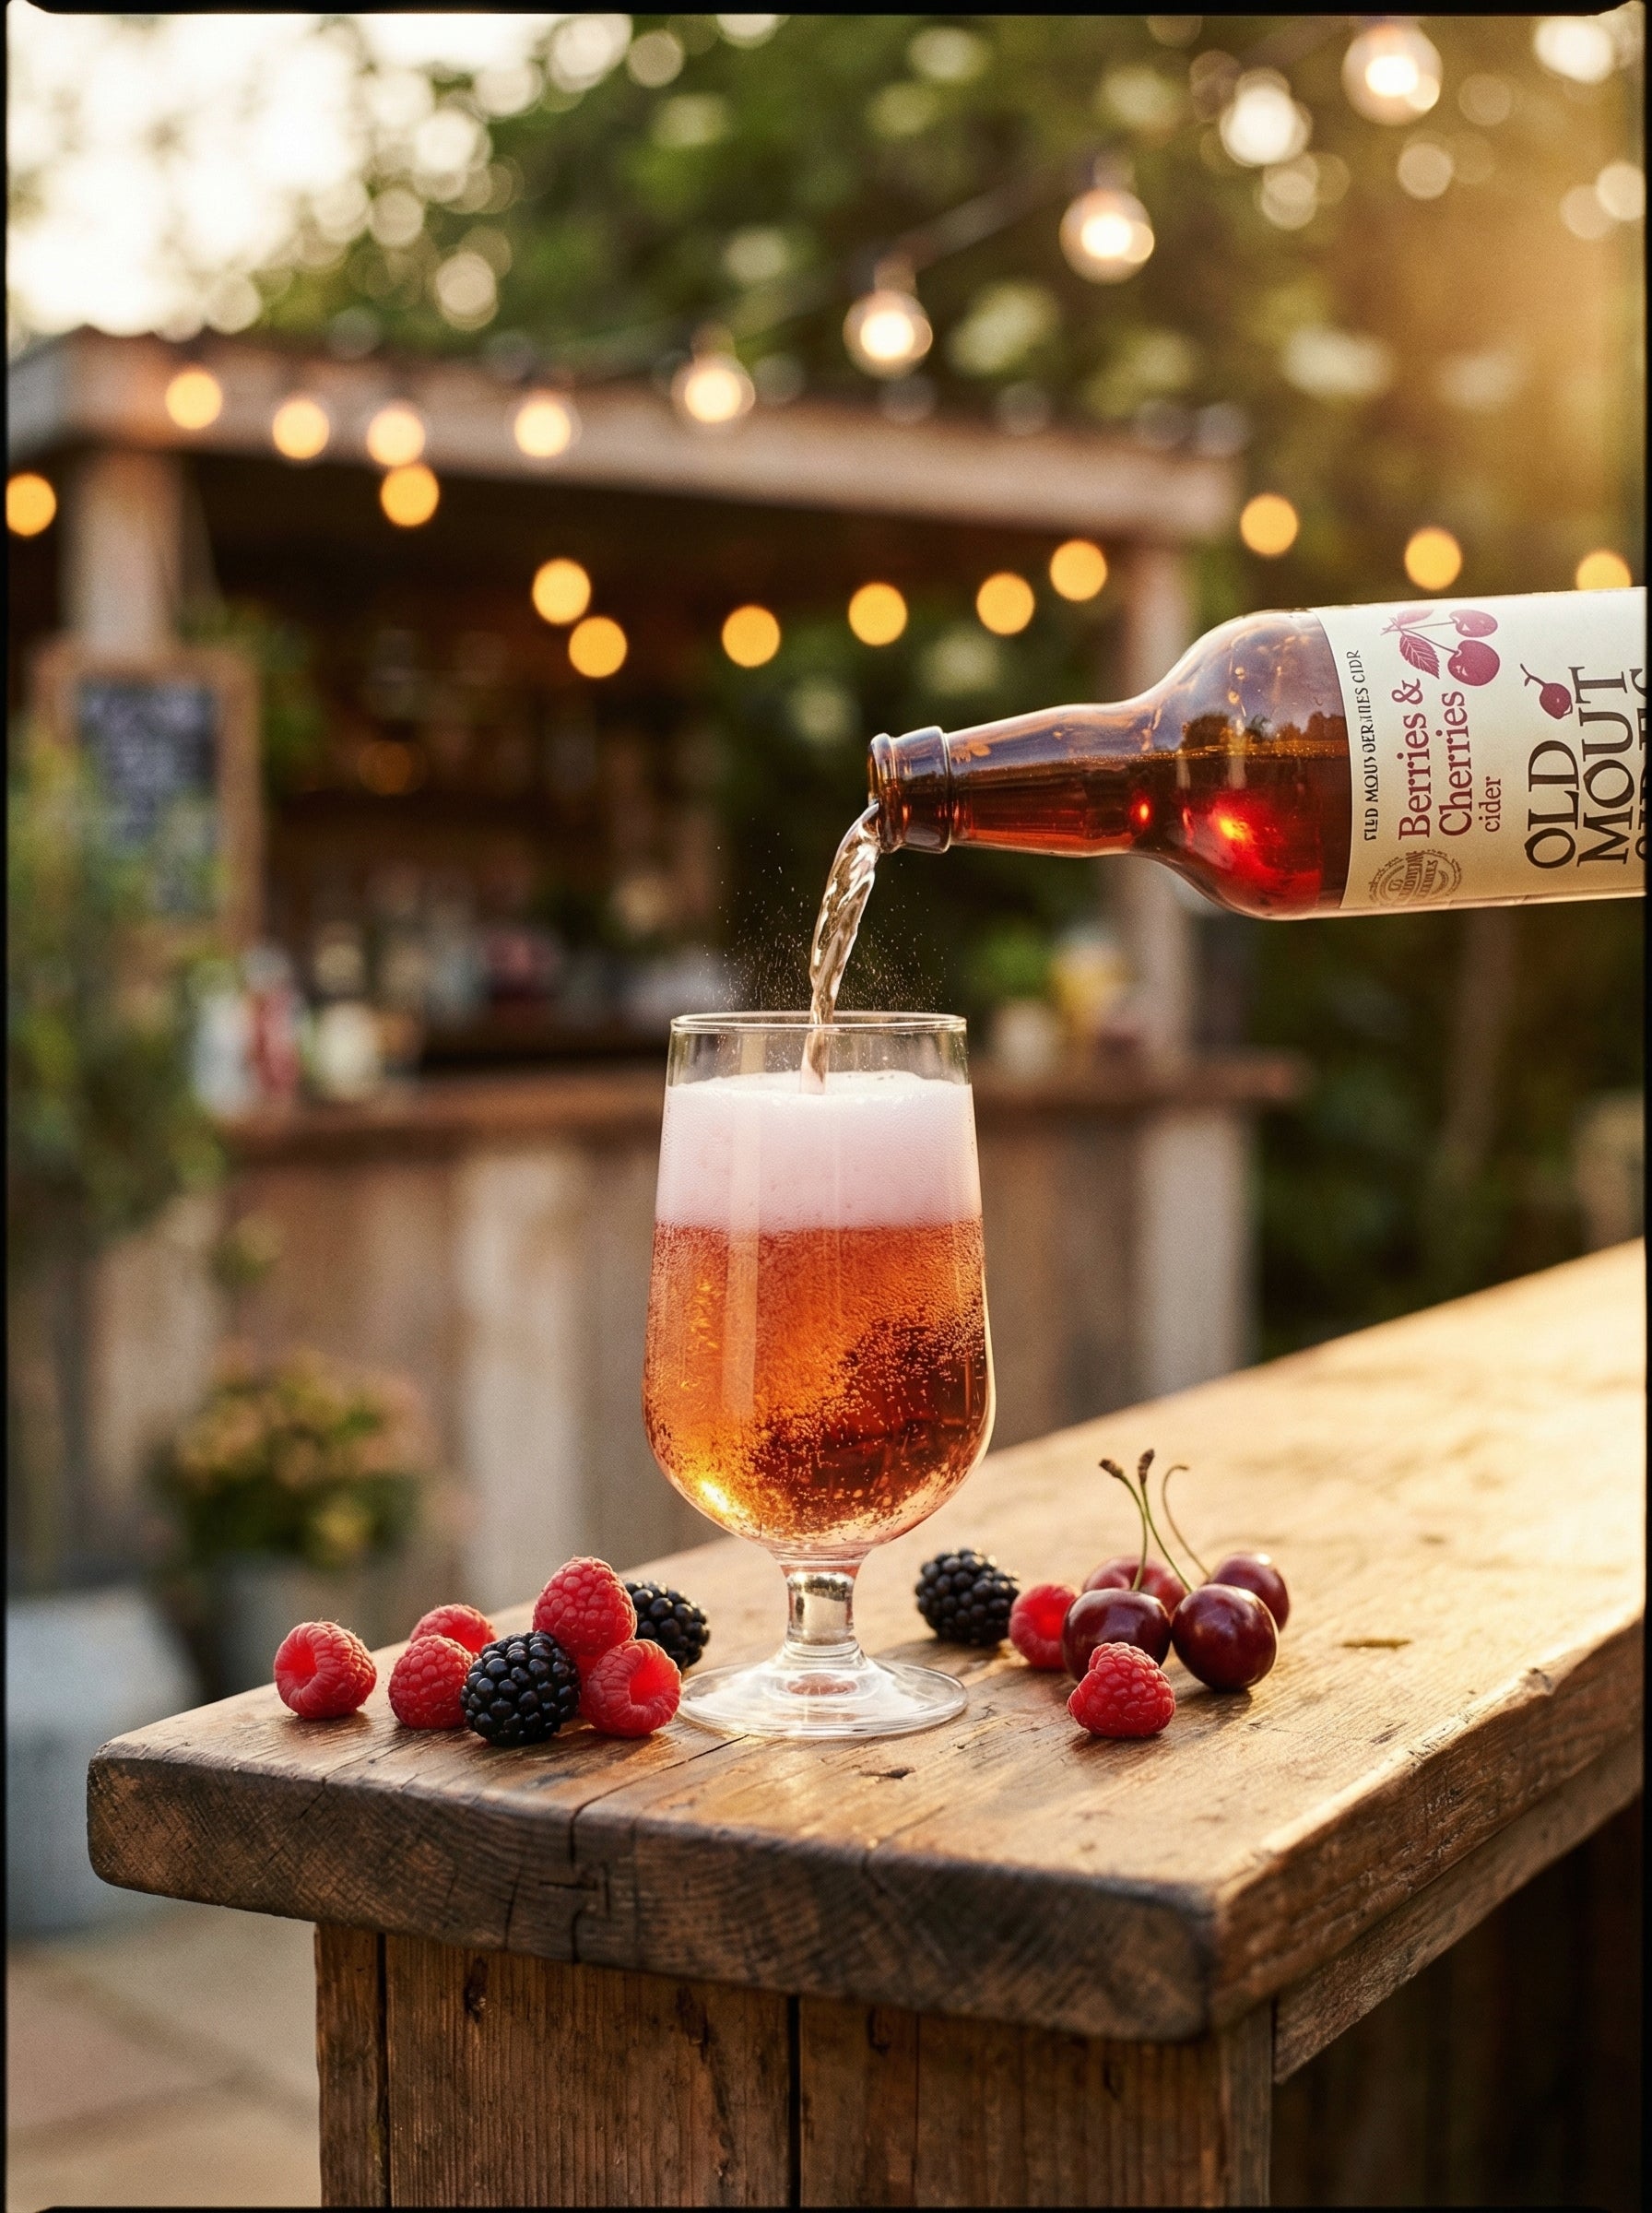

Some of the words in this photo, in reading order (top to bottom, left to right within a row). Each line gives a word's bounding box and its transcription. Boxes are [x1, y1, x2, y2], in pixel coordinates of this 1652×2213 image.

[1391, 679, 1423, 705] &
[1397, 711, 1432, 840] Berries
[1435, 691, 1473, 836] Cherries
[1479, 775, 1502, 833] cider
[1524, 740, 1580, 869] OLD
[1568, 666, 1635, 867] MOUT
